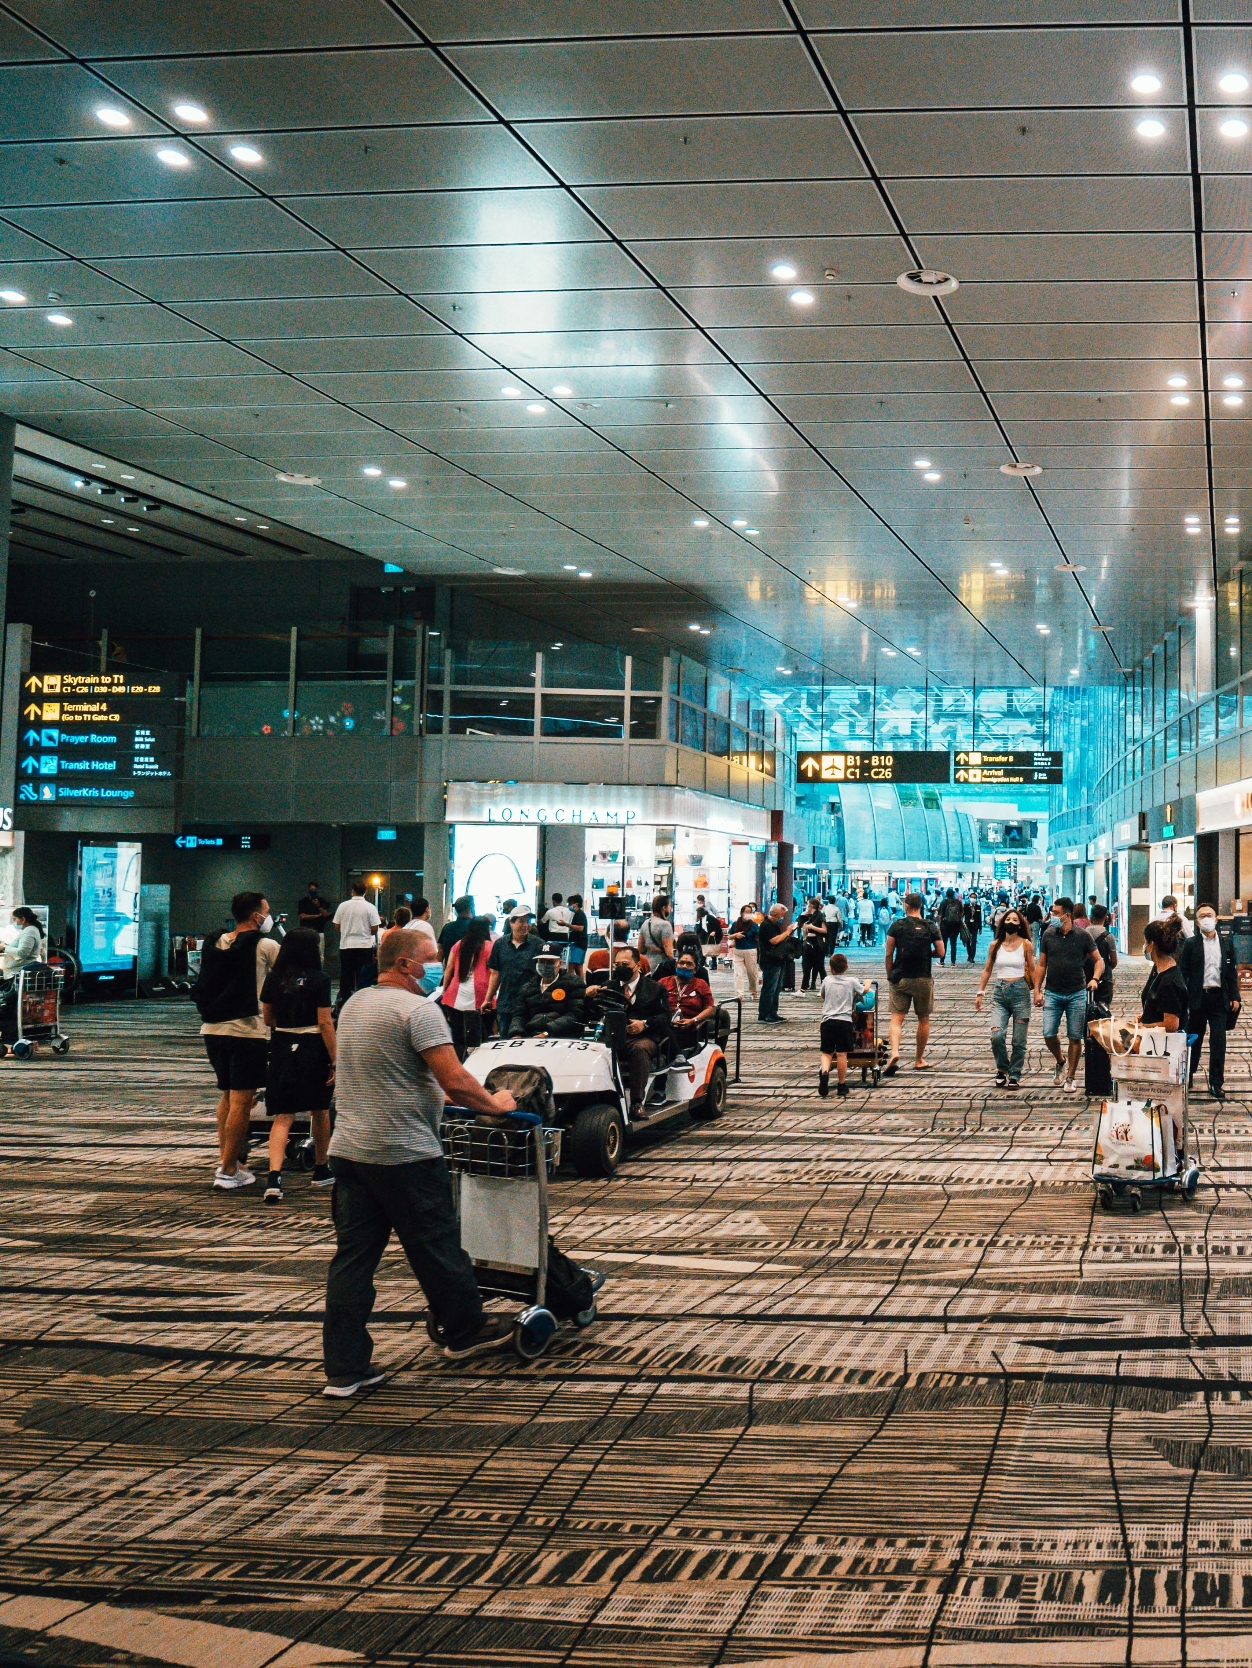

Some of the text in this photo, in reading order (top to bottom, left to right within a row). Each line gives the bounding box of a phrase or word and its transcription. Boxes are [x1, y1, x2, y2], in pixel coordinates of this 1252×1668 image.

[63, 675, 124, 686] Skytrain to T1
[63, 703, 107, 712] Terminal 4
[60, 734, 116, 744] Prayer Room
[60, 760, 116, 769] Transit Hotel
[847, 755, 860, 766] B1
[871, 755, 893, 766] B10
[846, 768, 860, 779] C1
[871, 768, 892, 779] C26
[58, 787, 134, 799] SilverKris Lounge
[487, 808, 637, 824] LONGCHAMP
[491, 1040, 590, 1051] EB 21 T3
